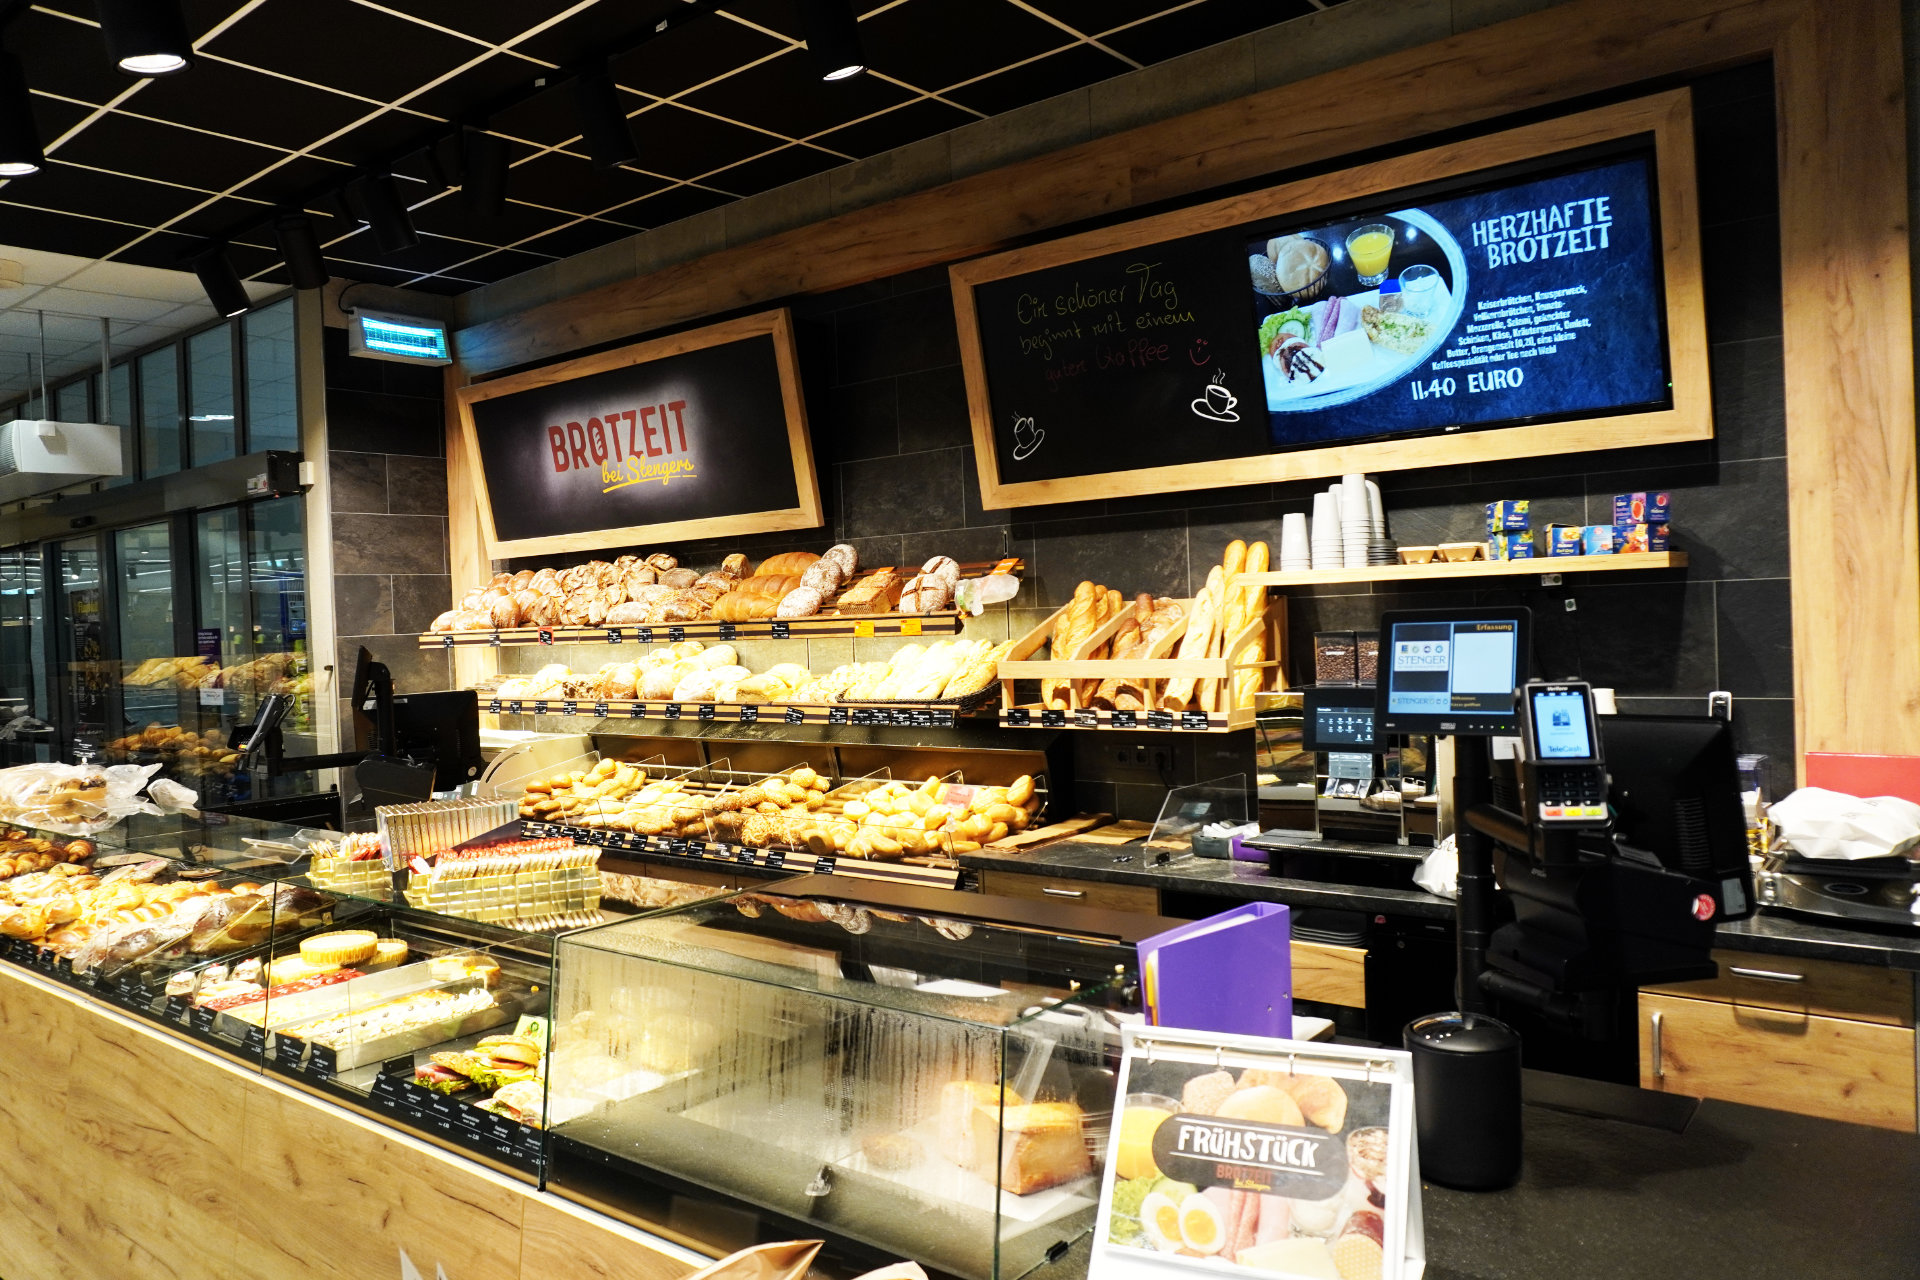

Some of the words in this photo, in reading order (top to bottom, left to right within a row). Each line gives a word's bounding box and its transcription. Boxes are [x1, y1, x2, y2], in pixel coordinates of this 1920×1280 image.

[1472, 196, 1612, 247] HERZHAFTE
[1487, 222, 1612, 269] BROTZEIT
[1017, 293, 1048, 325] Ein
[1055, 282, 1126, 317] schöner
[1125, 262, 1178, 310] Tag
[1477, 294, 1534, 311] Kaiserbrötchen,
[1466, 320, 1506, 334] Mozzarella,
[1506, 315, 1533, 327] Salami,
[1533, 310, 1571, 326] gekochter
[1473, 305, 1535, 322] Vollkornbrötchen,
[1535, 300, 1566, 312] Tomate-
[1019, 321, 1082, 361] beginnt
[1092, 311, 1126, 335] mit
[1136, 311, 1195, 331] einem
[1446, 347, 1471, 359] Butter,
[1471, 340, 1515, 355] Orangensaft
[1537, 335, 1553, 345] eine
[1553, 331, 1577, 343] kleine
[1458, 334, 1492, 346] Schinken,
[1491, 330, 1512, 341] Käse,
[1512, 321, 1564, 338] Kräuterquark,
[1095, 338, 1170, 370] Kaffee
[1431, 354, 1489, 371] Kaffeespezialität
[1488, 351, 1506, 363] oder
[1506, 350, 1520, 361] Tee
[1519, 347, 1538, 359] nach
[1537, 344, 1557, 356] Wahl
[1467, 367, 1524, 393] EURO
[548, 400, 688, 473] BROTZEIT
[602, 461, 624, 484] bei
[626, 456, 695, 485] Stengers
[1476, 623, 1513, 632] Erfassung
[1397, 655, 1446, 665] STENGER
[1397, 697, 1429, 705] STENGER
[1548, 745, 1582, 753] TeleCash
[1177, 1124, 1319, 1168] FRÜHSTÜCK
[1216, 1163, 1273, 1185] BROTZEIT
